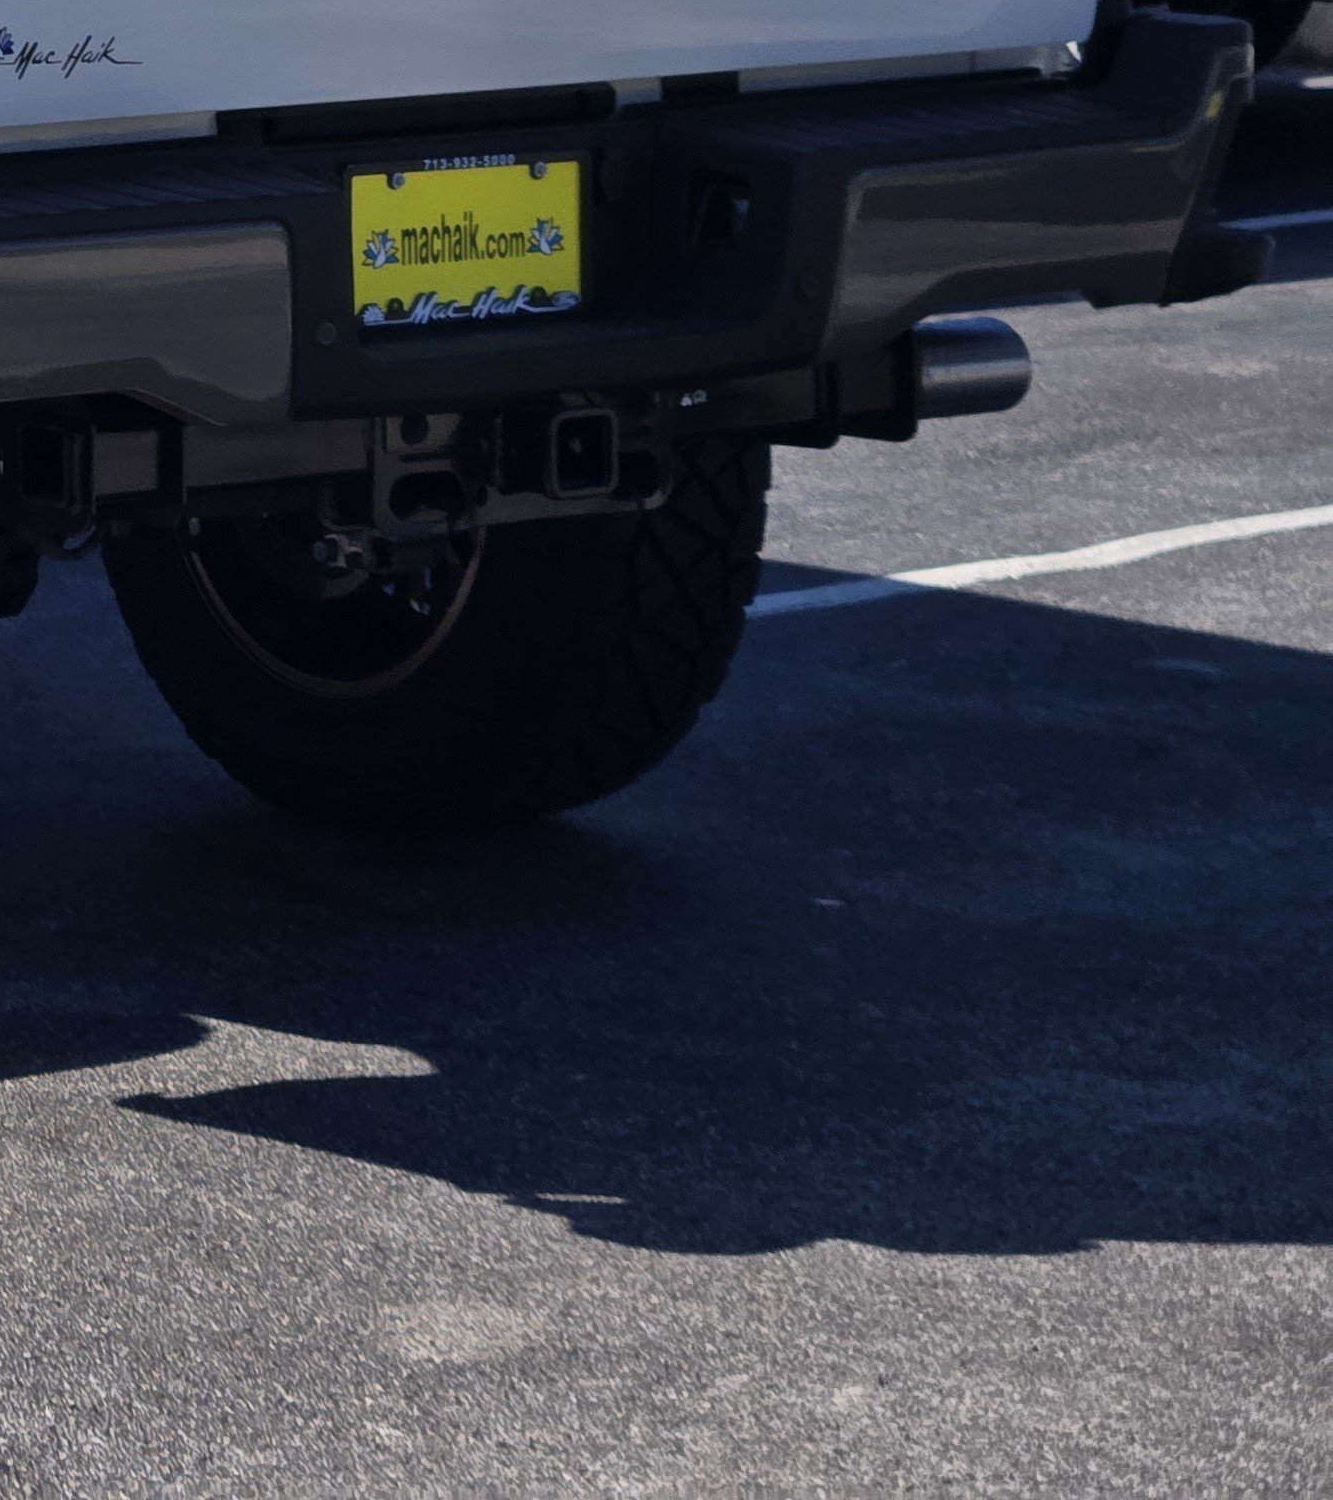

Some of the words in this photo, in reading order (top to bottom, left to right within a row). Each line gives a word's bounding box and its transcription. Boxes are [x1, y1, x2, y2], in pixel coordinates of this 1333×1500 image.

[14, 41, 61, 80] Mac
[61, 35, 123, 80] Haik
[400, 211, 527, 265] machaik.com
[409, 291, 465, 324] Mac
[471, 284, 535, 320] Haik
